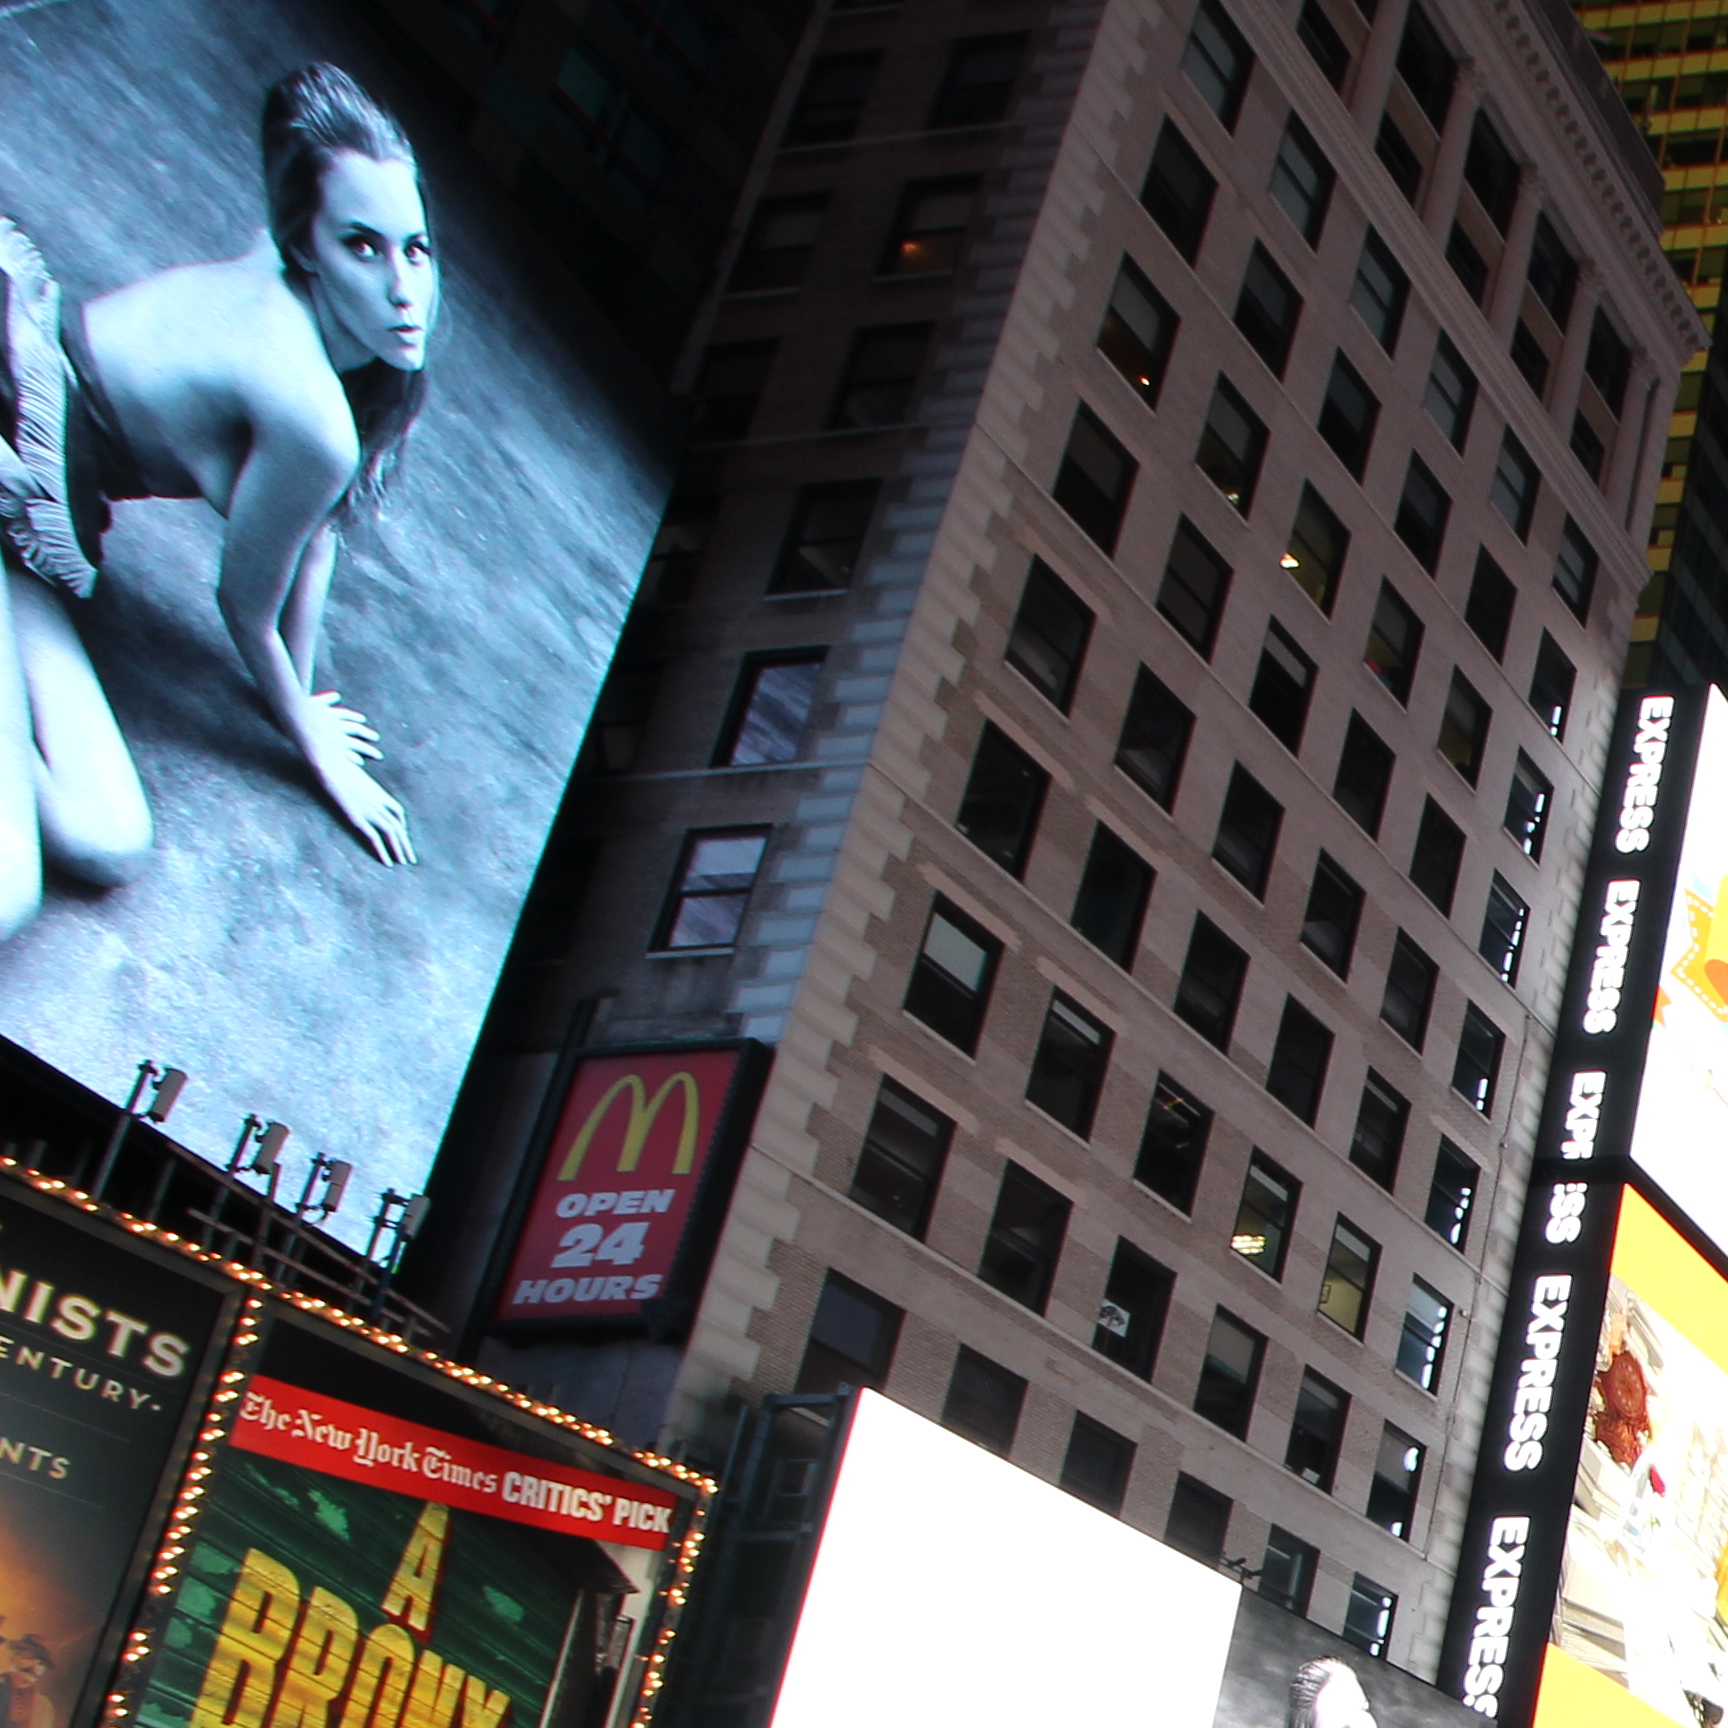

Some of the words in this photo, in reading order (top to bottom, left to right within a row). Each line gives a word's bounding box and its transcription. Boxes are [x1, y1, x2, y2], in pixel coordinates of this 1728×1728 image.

[1614, 695, 1674, 854] EXPRESS
[1582, 879, 1641, 1036] EXPRESS
[550, 1219, 649, 1270] 24
[555, 1188, 676, 1219] OPEN
[512, 1273, 663, 1306] HOURS
[1503, 1274, 1573, 1473] EXPRESS
[240, 1389, 293, 1433] The
[293, 1410, 352, 1453] New
[354, 1428, 420, 1476] York
[421, 1446, 497, 1495] Times
[501, 1469, 613, 1522] CRITICS'
[613, 1494, 671, 1536] PICK
[381, 1501, 450, 1634] A
